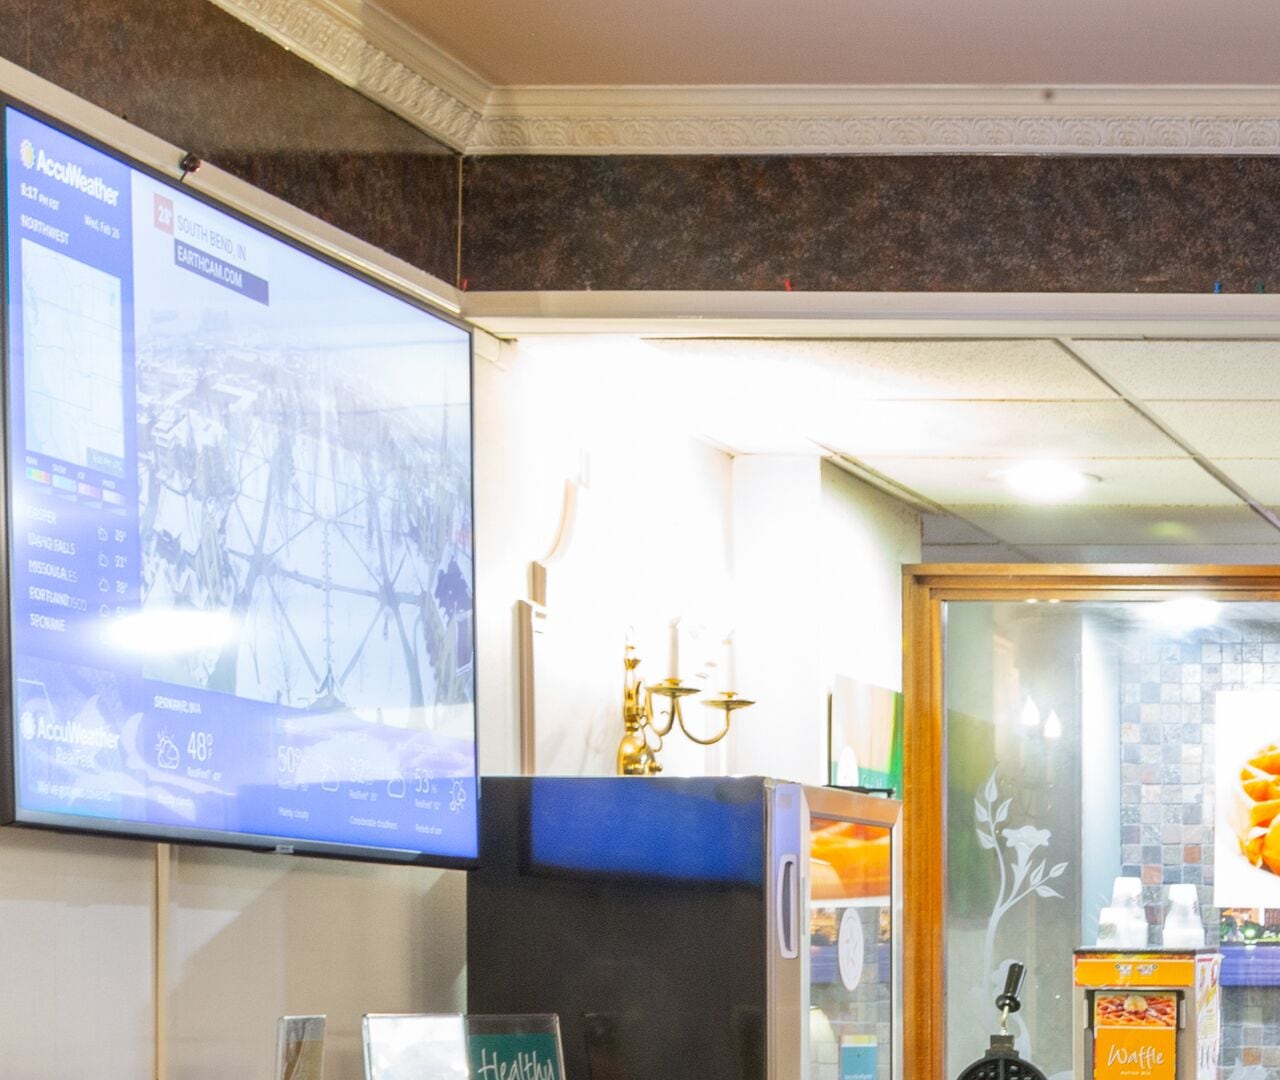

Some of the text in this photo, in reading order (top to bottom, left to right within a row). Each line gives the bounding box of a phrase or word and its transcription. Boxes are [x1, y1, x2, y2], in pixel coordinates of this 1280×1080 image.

[37, 149, 119, 207] AccuWeather
[177, 214, 208, 243] SOUTH
[177, 245, 243, 289] EARTHCAM.COM
[37, 716, 120, 750] AccuWeather
[1107, 1044, 1165, 1070] Waffle
